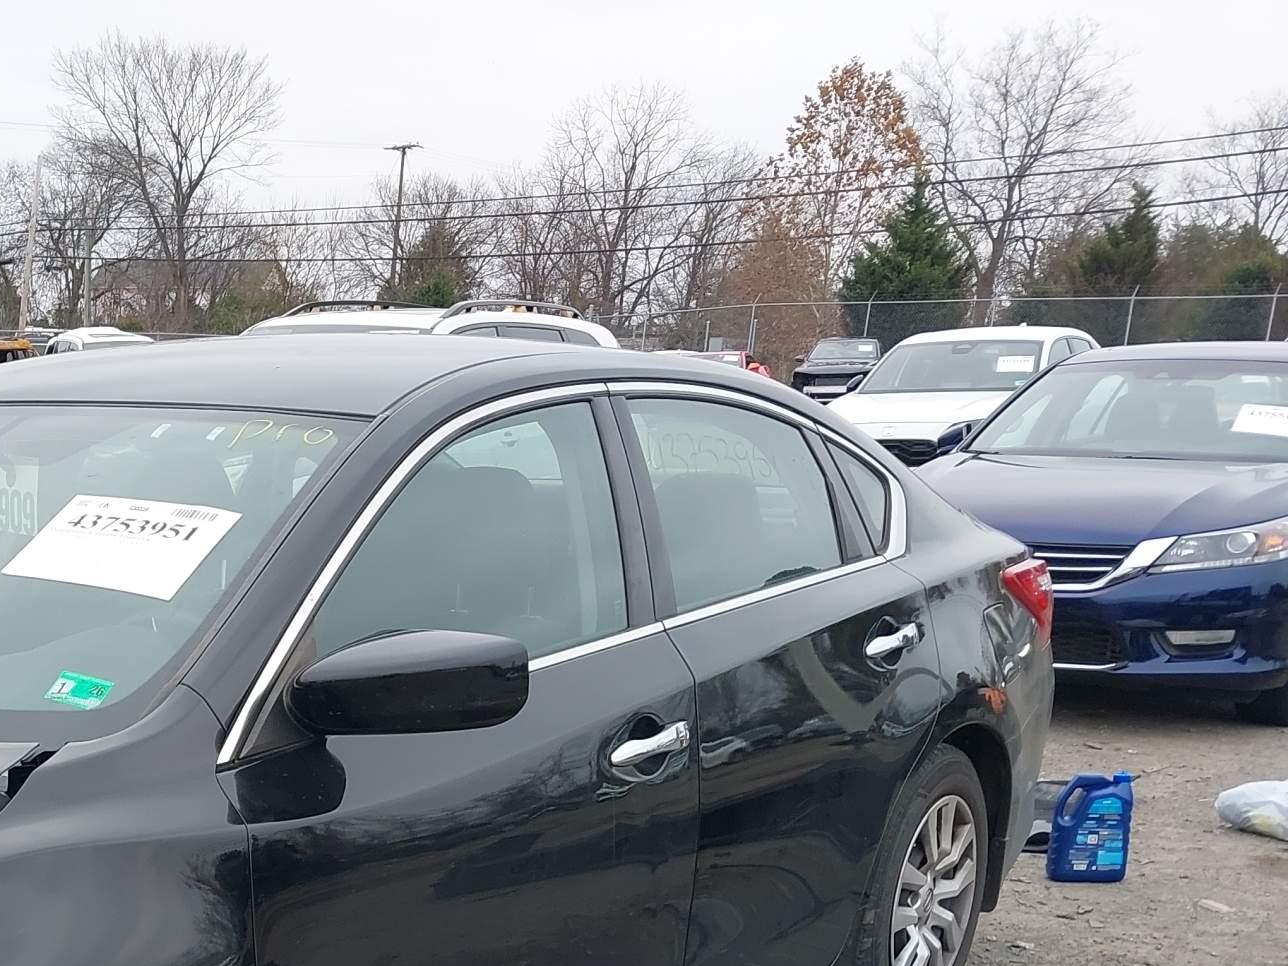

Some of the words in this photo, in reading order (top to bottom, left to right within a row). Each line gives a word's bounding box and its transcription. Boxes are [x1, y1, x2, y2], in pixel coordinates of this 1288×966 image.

[67, 513, 200, 542] 43753951
[51, 682, 70, 695] 1
[89, 684, 107, 698] 26
